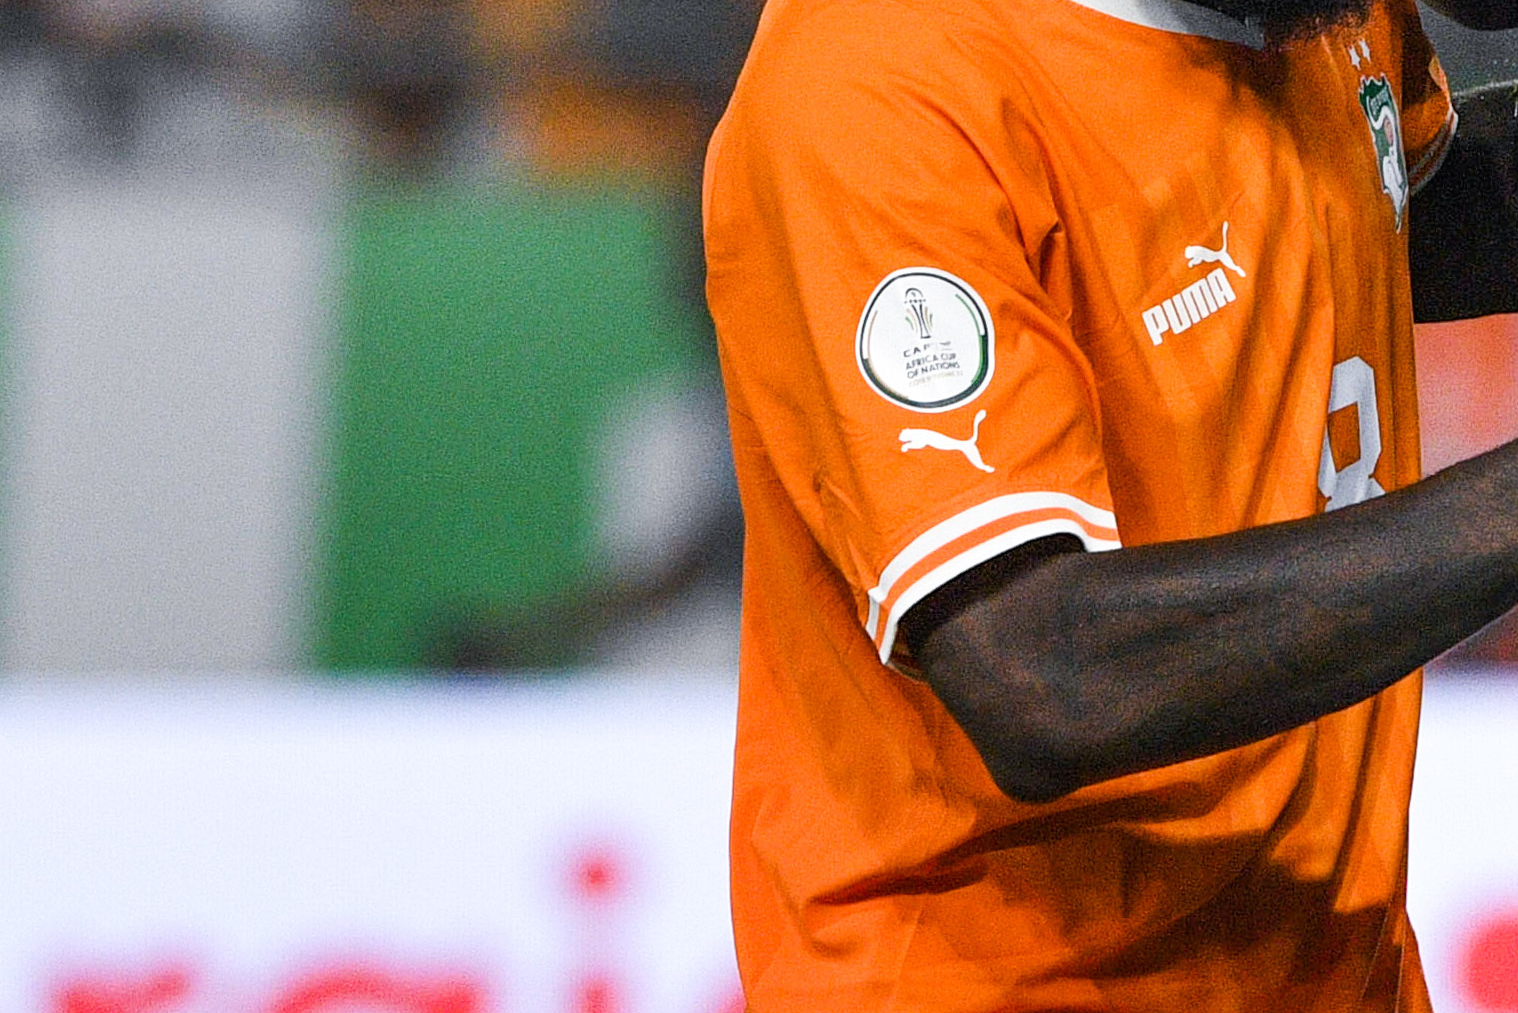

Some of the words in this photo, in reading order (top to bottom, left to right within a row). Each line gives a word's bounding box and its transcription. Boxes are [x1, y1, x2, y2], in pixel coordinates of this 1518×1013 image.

[1142, 268, 1236, 346] PUMA
[906, 354, 938, 370] AFRICA
[921, 361, 961, 374] NATIONS
